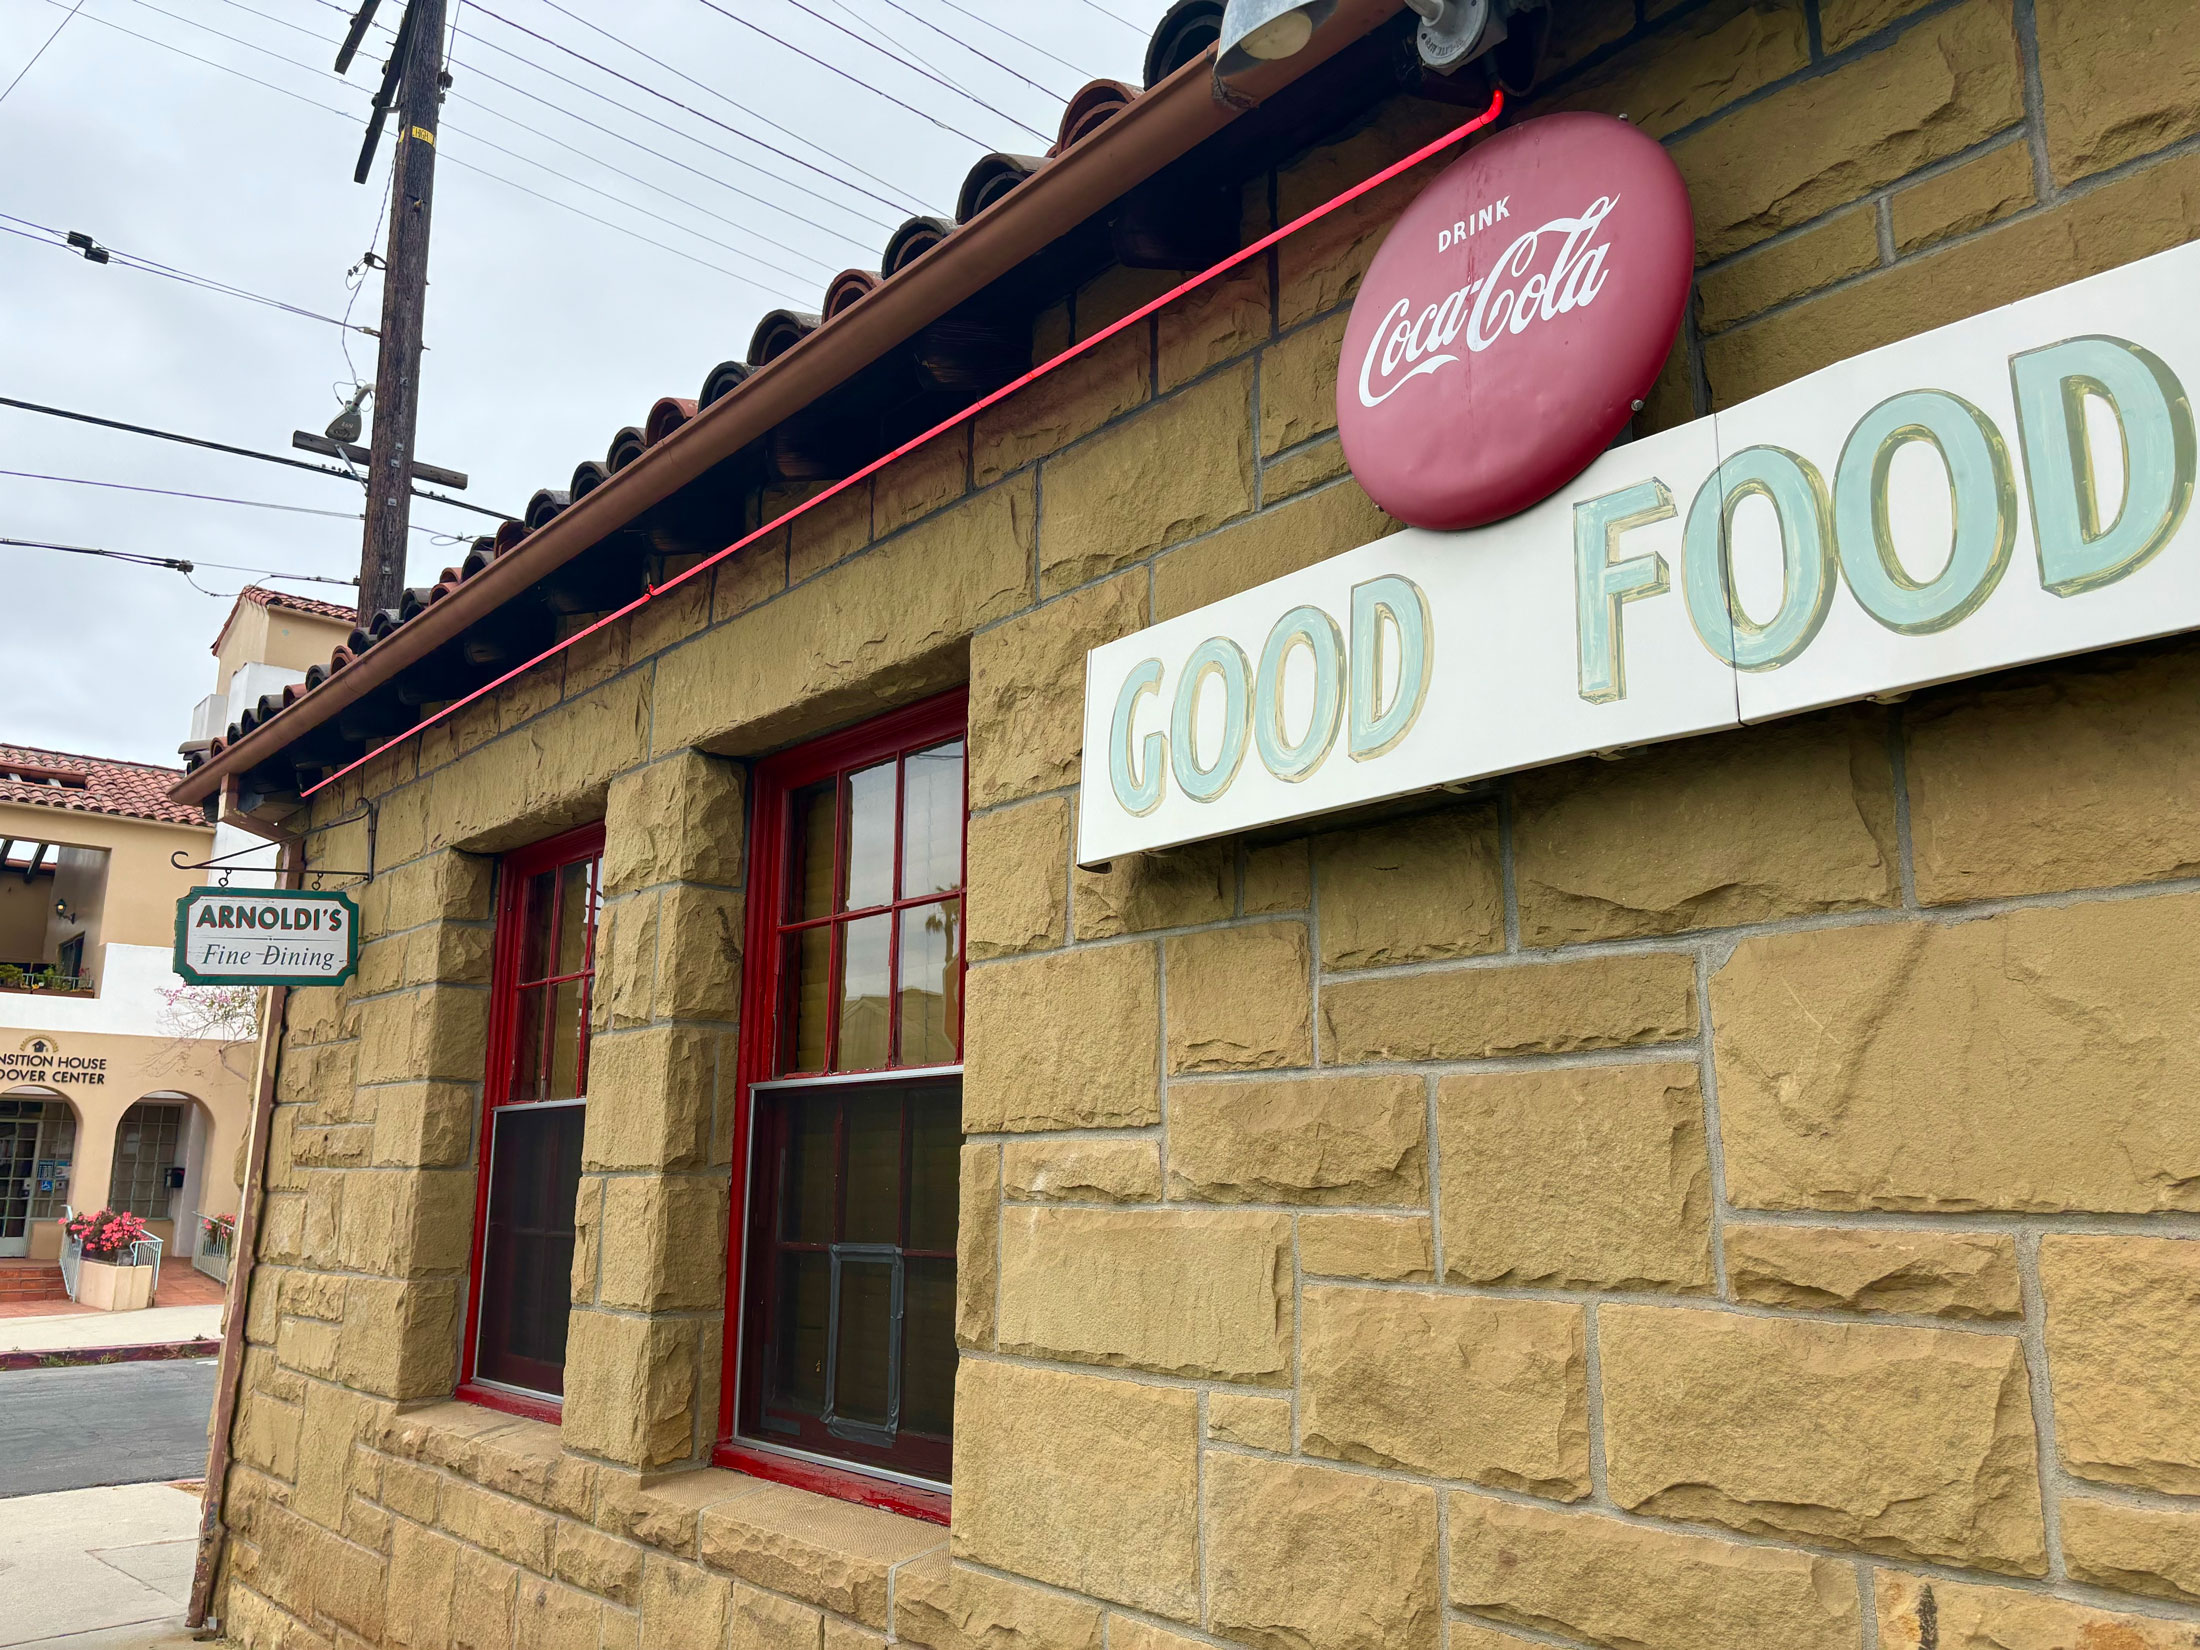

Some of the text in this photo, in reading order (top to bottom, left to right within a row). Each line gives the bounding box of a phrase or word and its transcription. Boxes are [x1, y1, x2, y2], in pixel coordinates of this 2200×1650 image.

[1438, 195, 1511, 254] DRINK
[1358, 193, 1621, 408] Coca-Cola
[1108, 333, 2196, 818] GOOD FOOD
[196, 904, 342, 932] ARNOLDI'S
[201, 943, 335, 971] Fine Dining
[57, 1056, 107, 1070] HOUSE
[52, 1071, 105, 1085] CENTER
